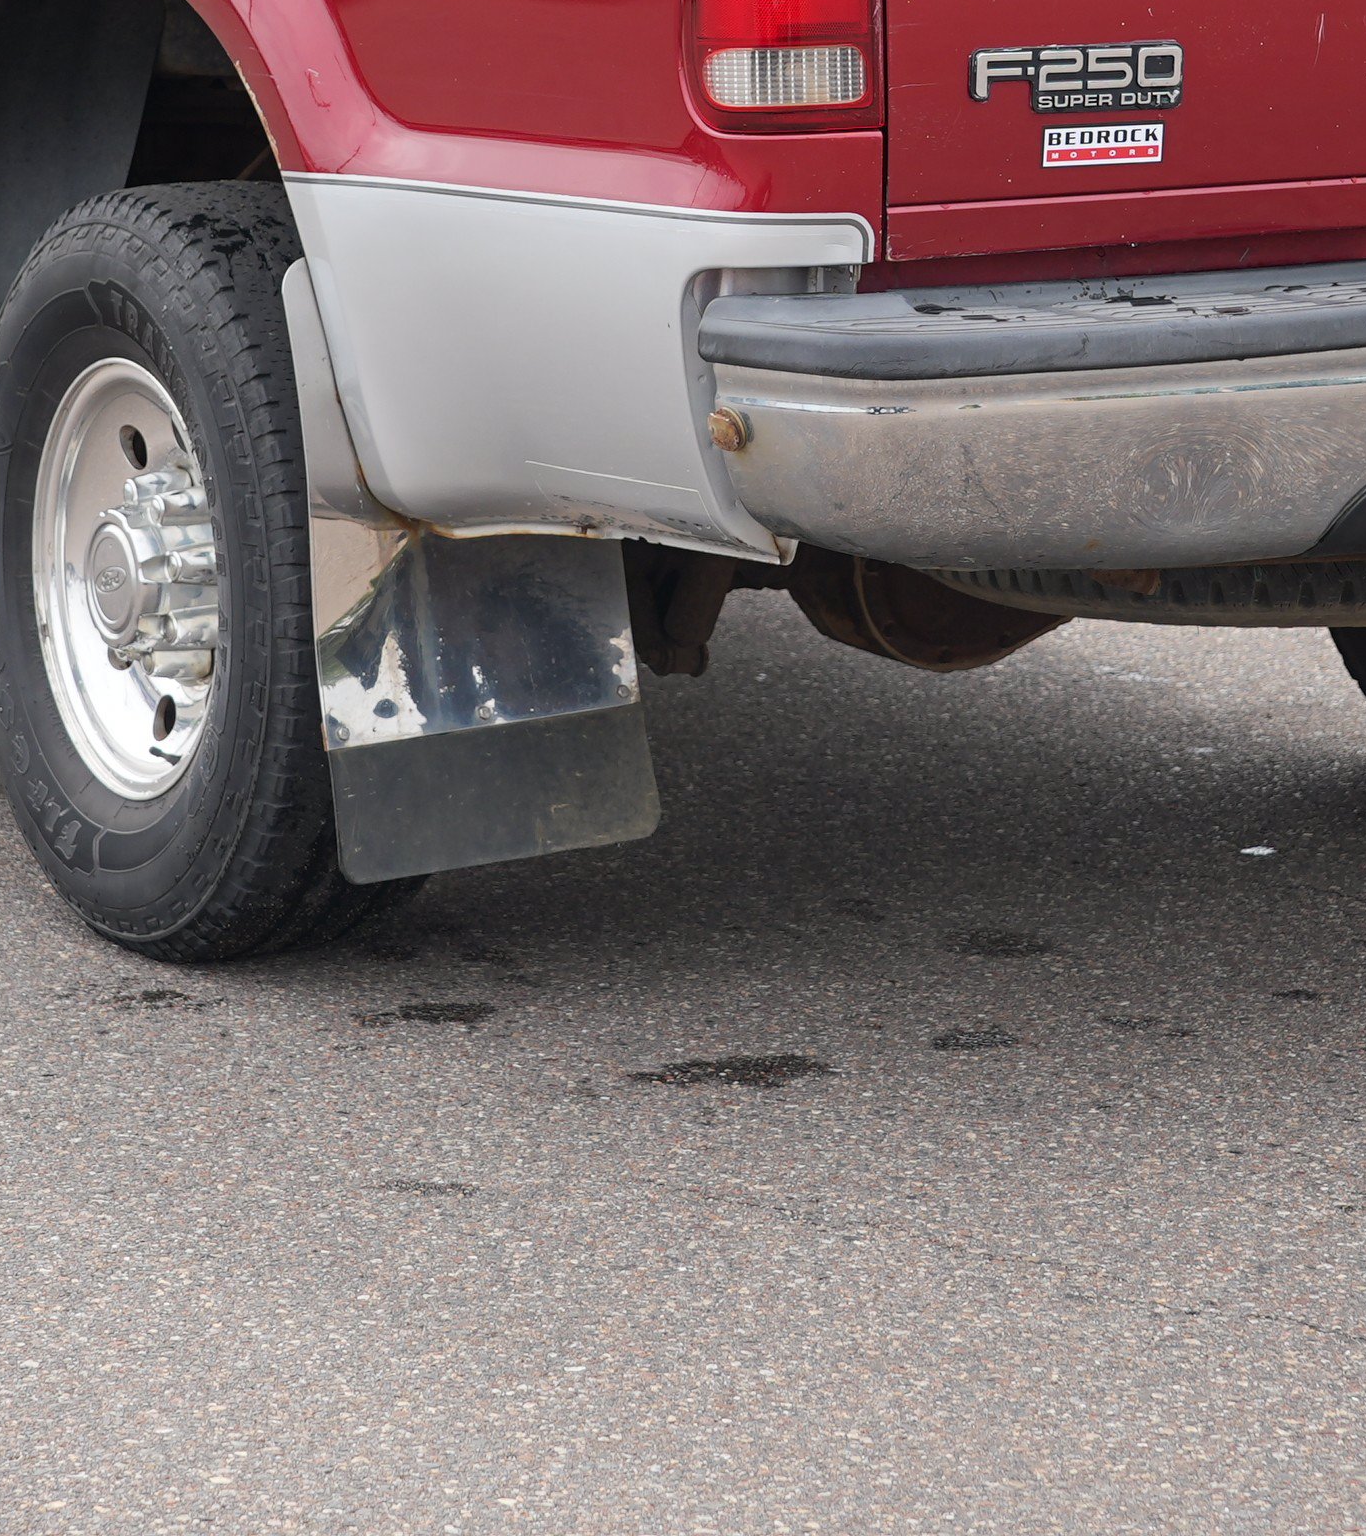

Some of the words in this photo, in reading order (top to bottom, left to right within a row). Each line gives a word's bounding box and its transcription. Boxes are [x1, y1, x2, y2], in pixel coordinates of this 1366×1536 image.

[1038, 92, 1113, 110] SUPER
[1120, 89, 1181, 106] DUTY
[1048, 127, 1159, 146] BEDROCK
[1051, 147, 1155, 159] MOTORS
